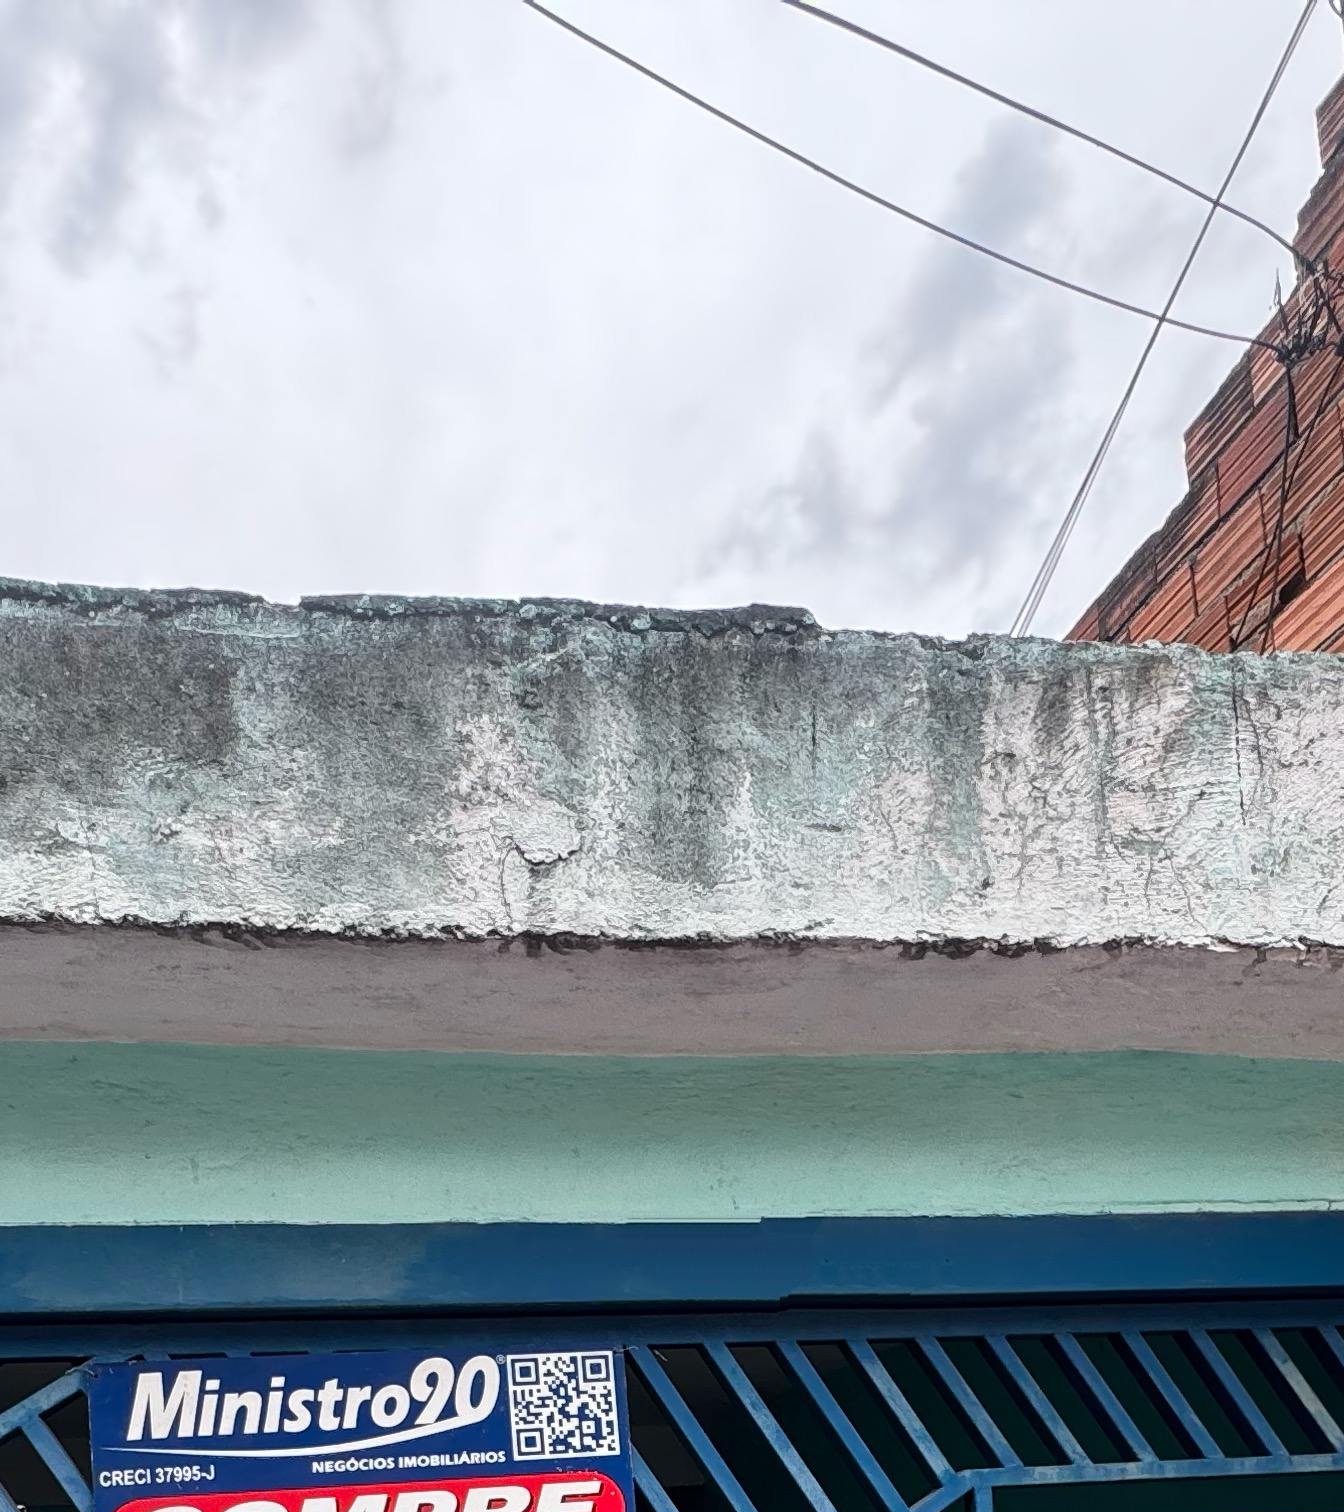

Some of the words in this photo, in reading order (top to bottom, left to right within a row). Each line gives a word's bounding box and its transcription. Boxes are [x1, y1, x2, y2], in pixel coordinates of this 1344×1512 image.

[126, 1355, 500, 1441] Ministro90
[312, 1457, 395, 1473] NEGÓCIOS
[398, 1450, 506, 1469] IMOBILIÁRIOS
[99, 1471, 152, 1487] CRECI
[155, 1465, 216, 1484] 37995-J
